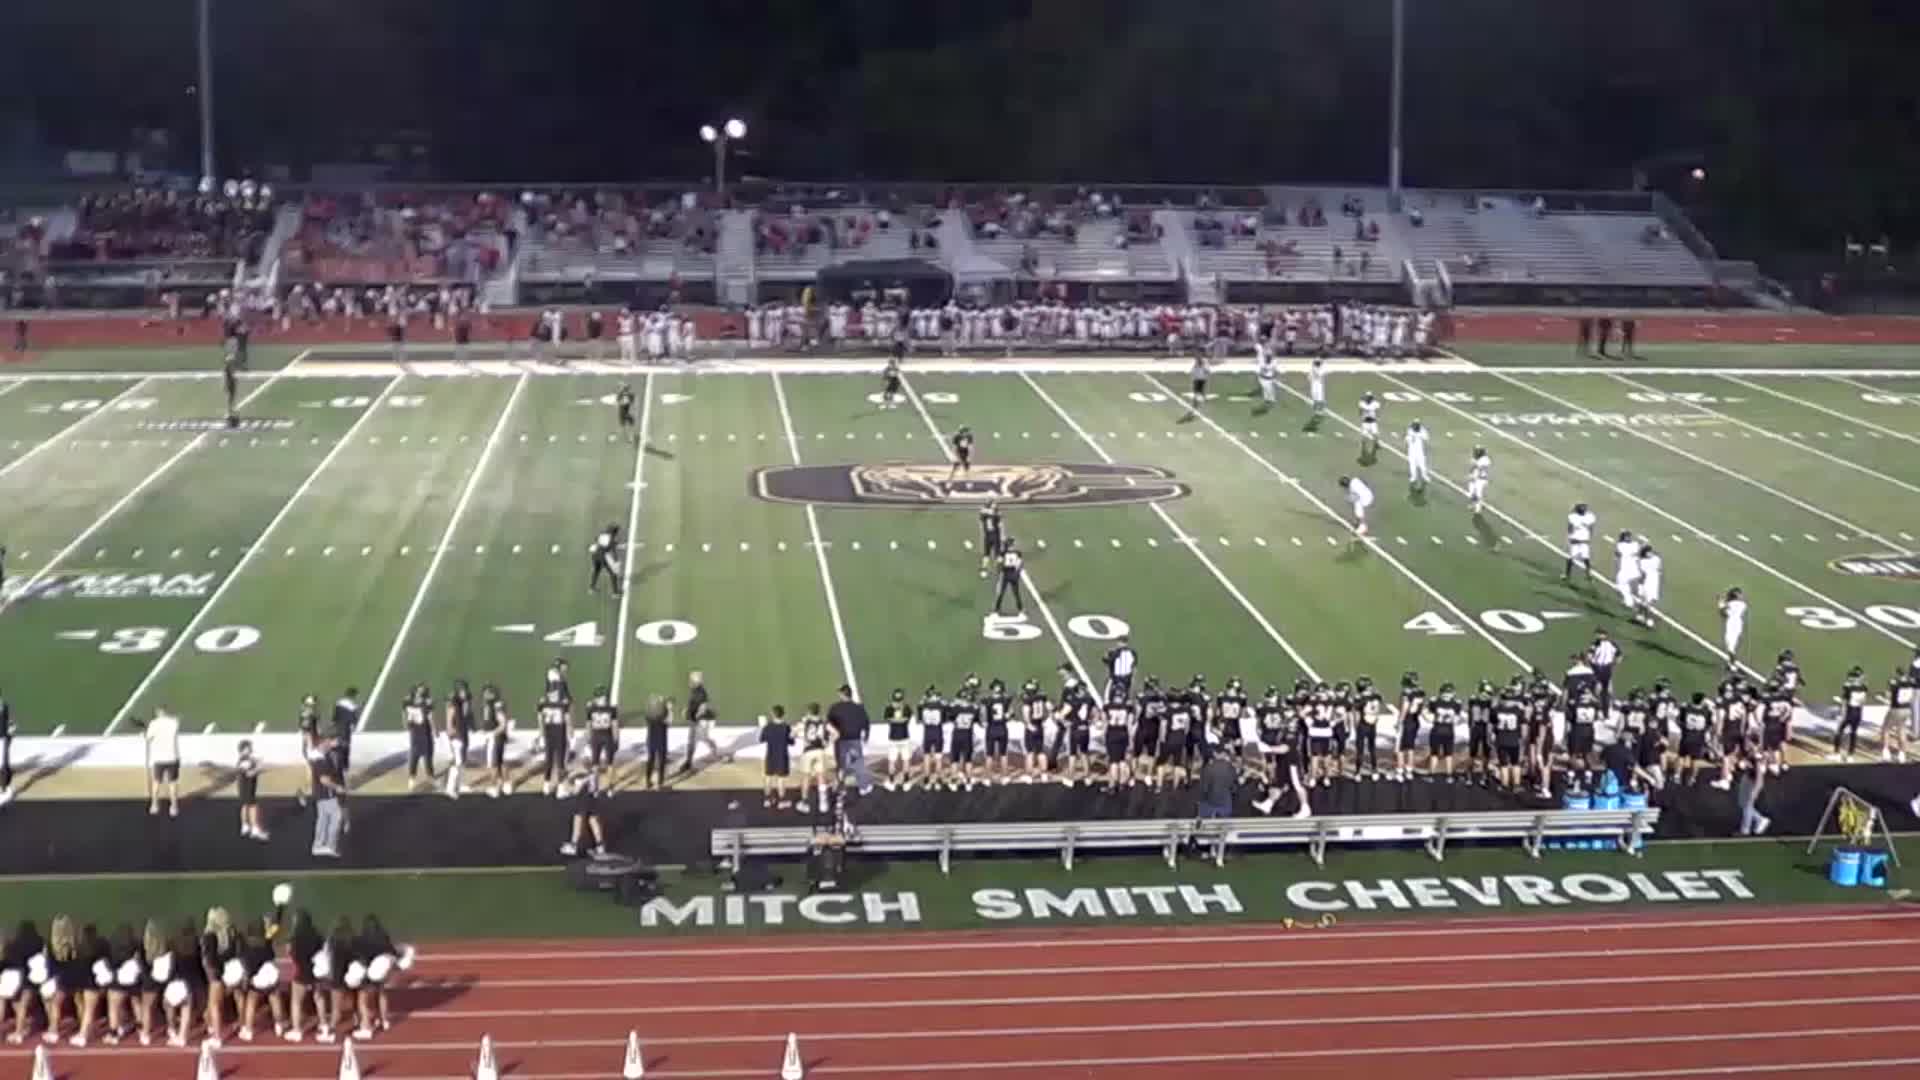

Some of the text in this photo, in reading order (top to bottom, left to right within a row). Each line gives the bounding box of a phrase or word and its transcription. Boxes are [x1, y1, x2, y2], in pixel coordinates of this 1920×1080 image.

[640, 869, 1755, 927] MITCH SMITH CHEVROLET
